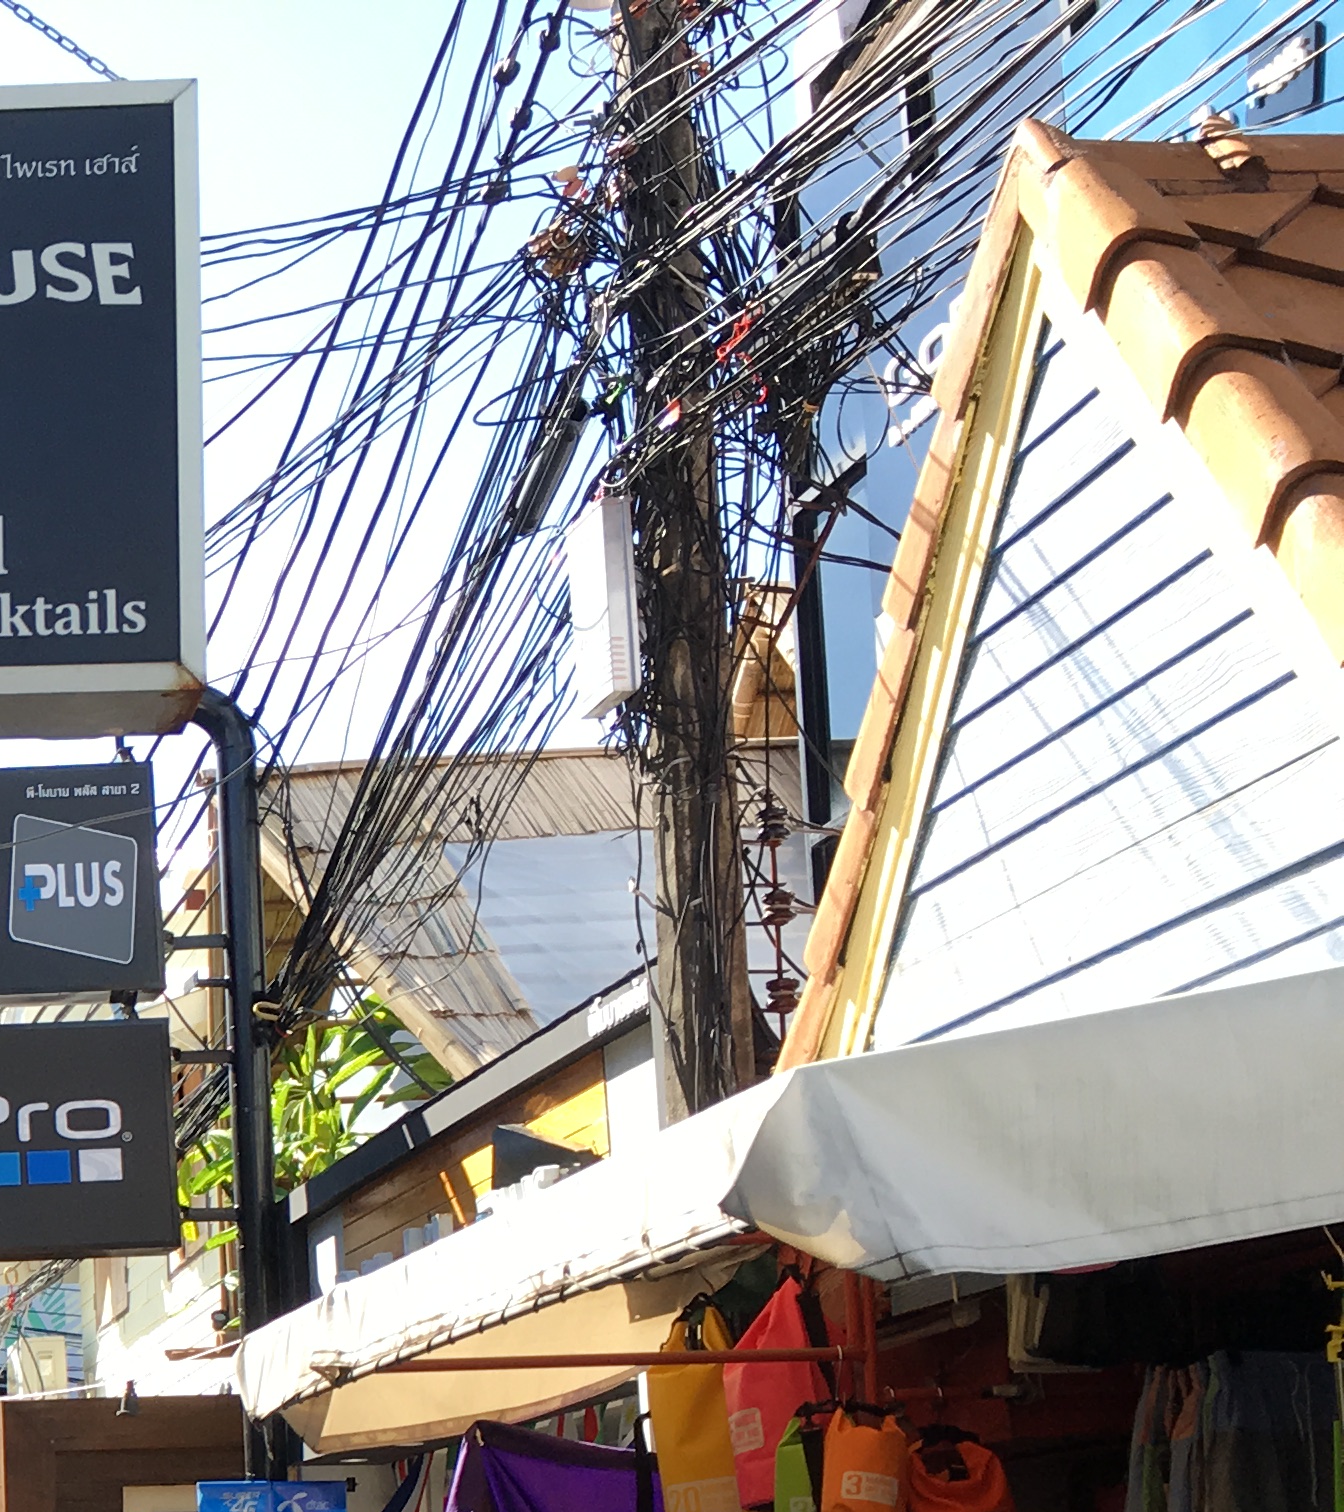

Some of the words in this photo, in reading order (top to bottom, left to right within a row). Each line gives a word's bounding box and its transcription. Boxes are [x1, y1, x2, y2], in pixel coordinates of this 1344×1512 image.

[131, 783, 140, 794] 2
[20, 860, 125, 911] PLUS
[845, 1473, 862, 1496] 3
